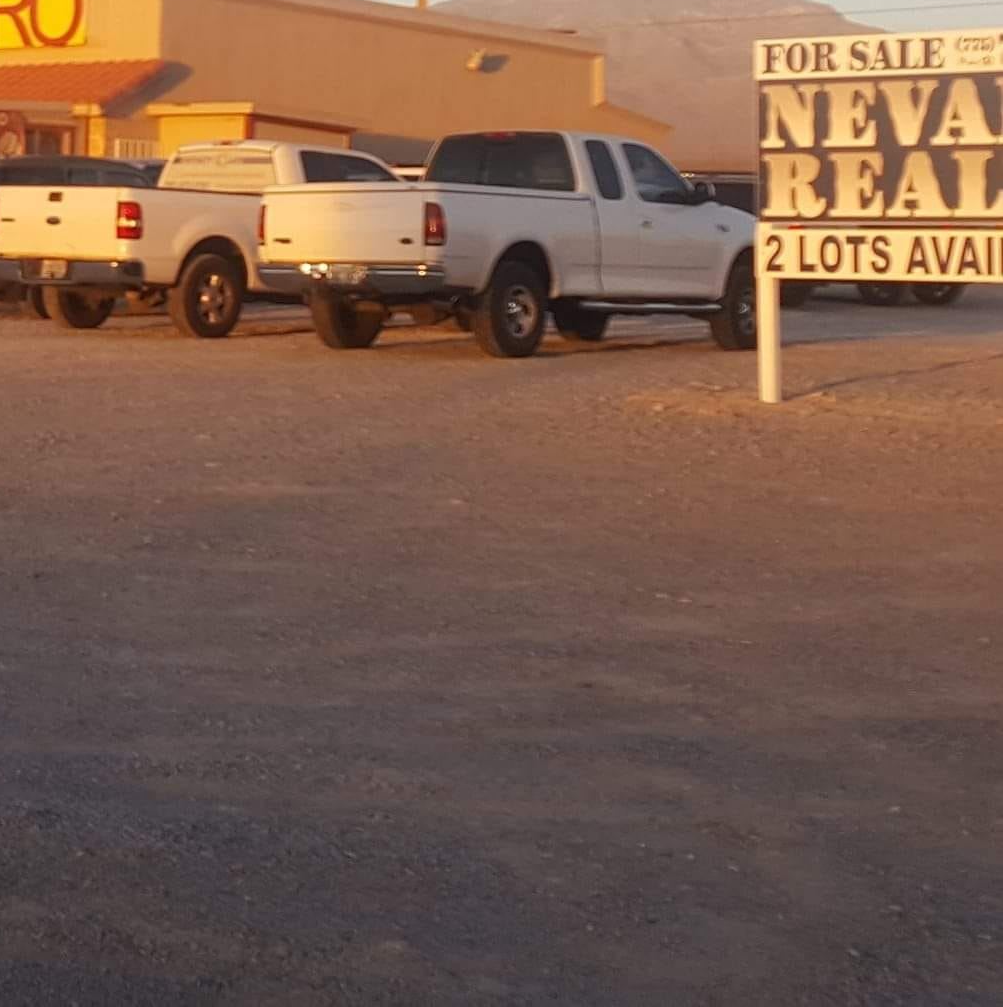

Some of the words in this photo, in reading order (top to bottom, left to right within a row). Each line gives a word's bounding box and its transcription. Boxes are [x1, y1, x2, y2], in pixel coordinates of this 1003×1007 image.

[762, 42, 839, 74] FOR
[849, 38, 945, 70] SALE
[760, 77, 1003, 148] NEVA
[765, 235, 784, 272] 2
[799, 235, 892, 273] LOTS
[906, 236, 1003, 275] AVAI
